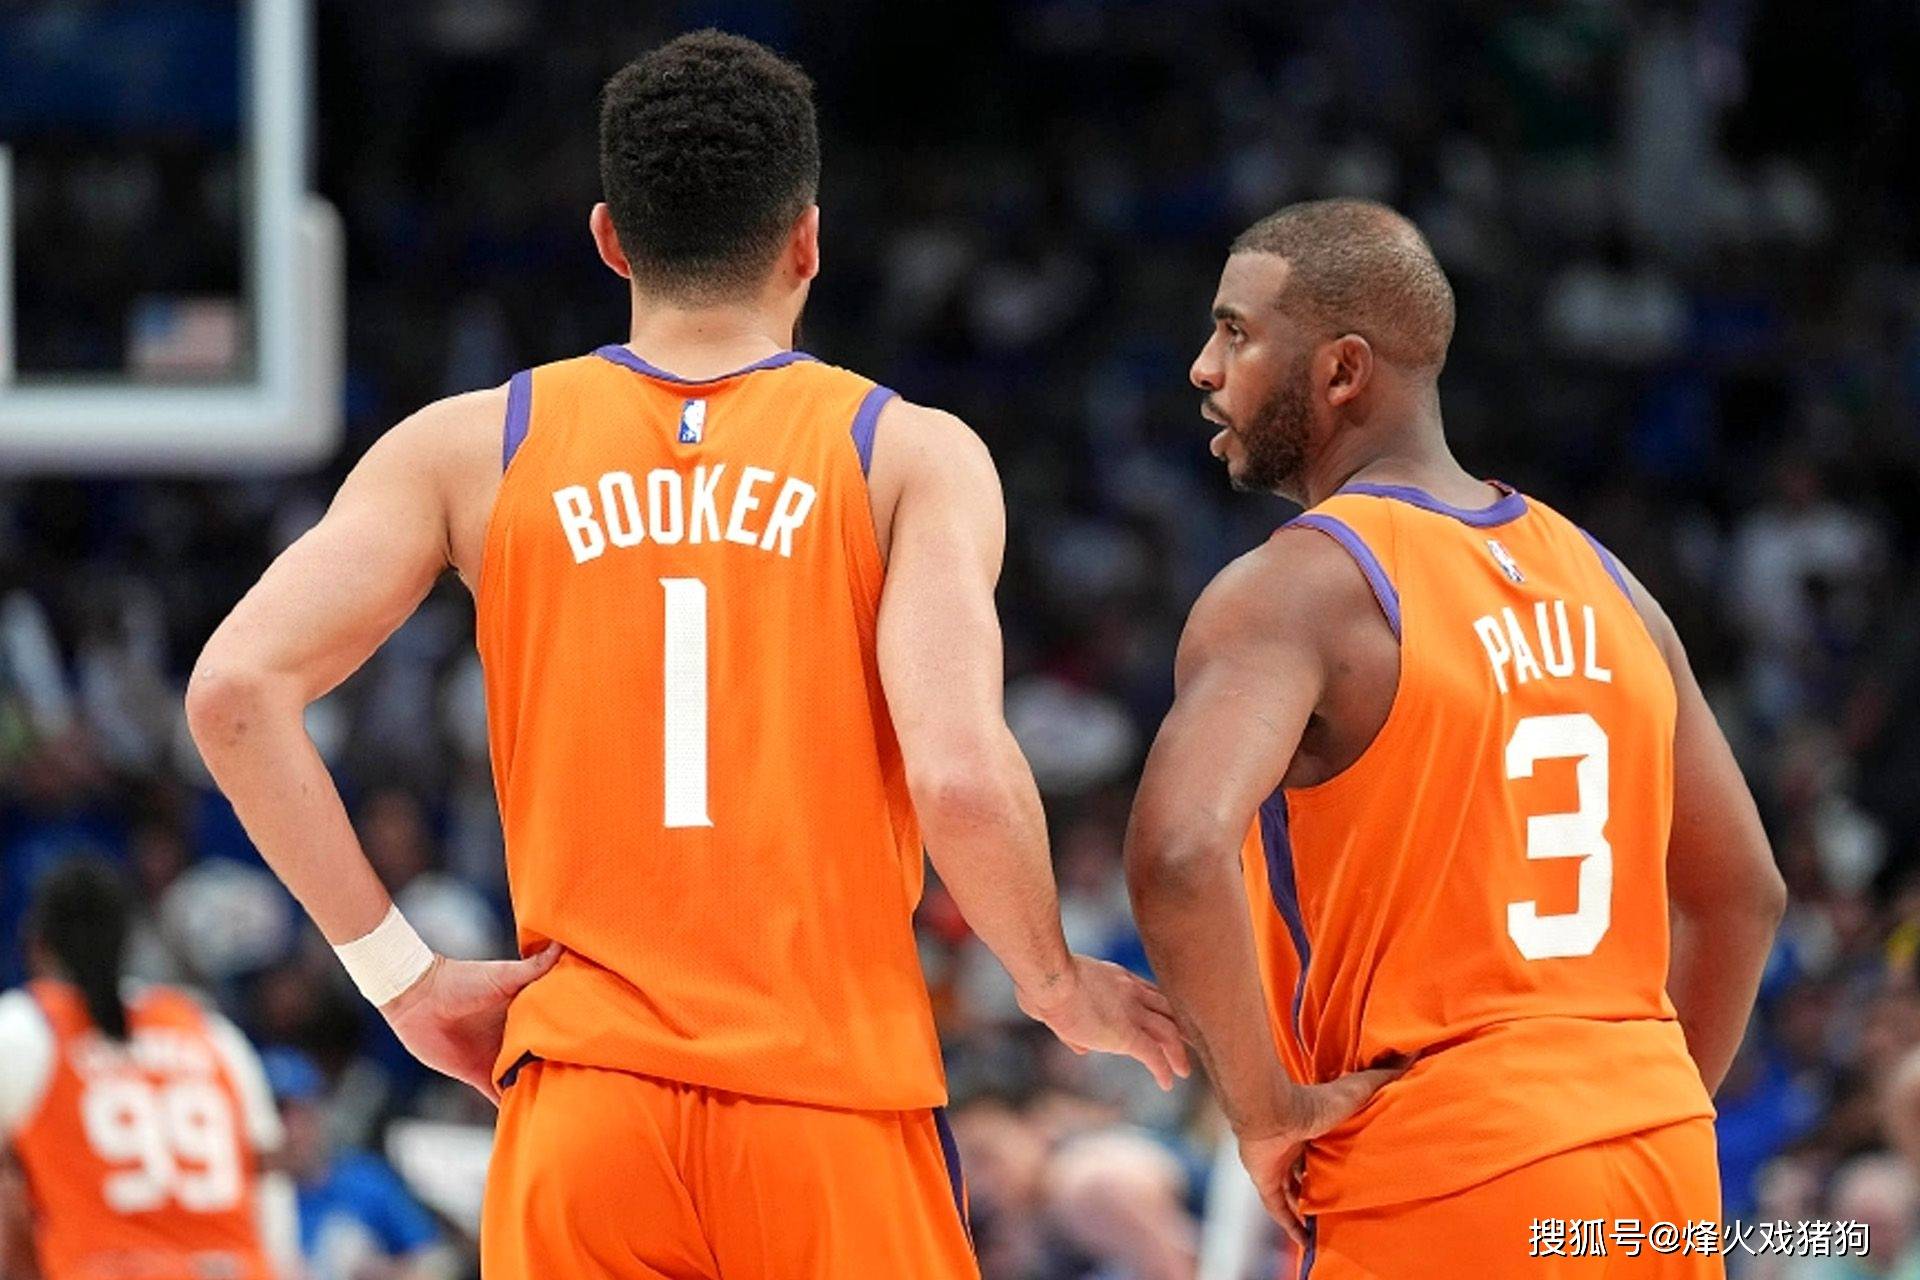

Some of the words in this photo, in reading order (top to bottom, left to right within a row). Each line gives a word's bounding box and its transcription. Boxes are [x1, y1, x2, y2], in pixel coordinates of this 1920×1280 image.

[553, 463, 817, 564] BOOKER
[659, 577, 714, 828] 1
[1473, 600, 1612, 694] PAUL
[1505, 713, 1613, 960] 3
[80, 1077, 243, 1214] 99
